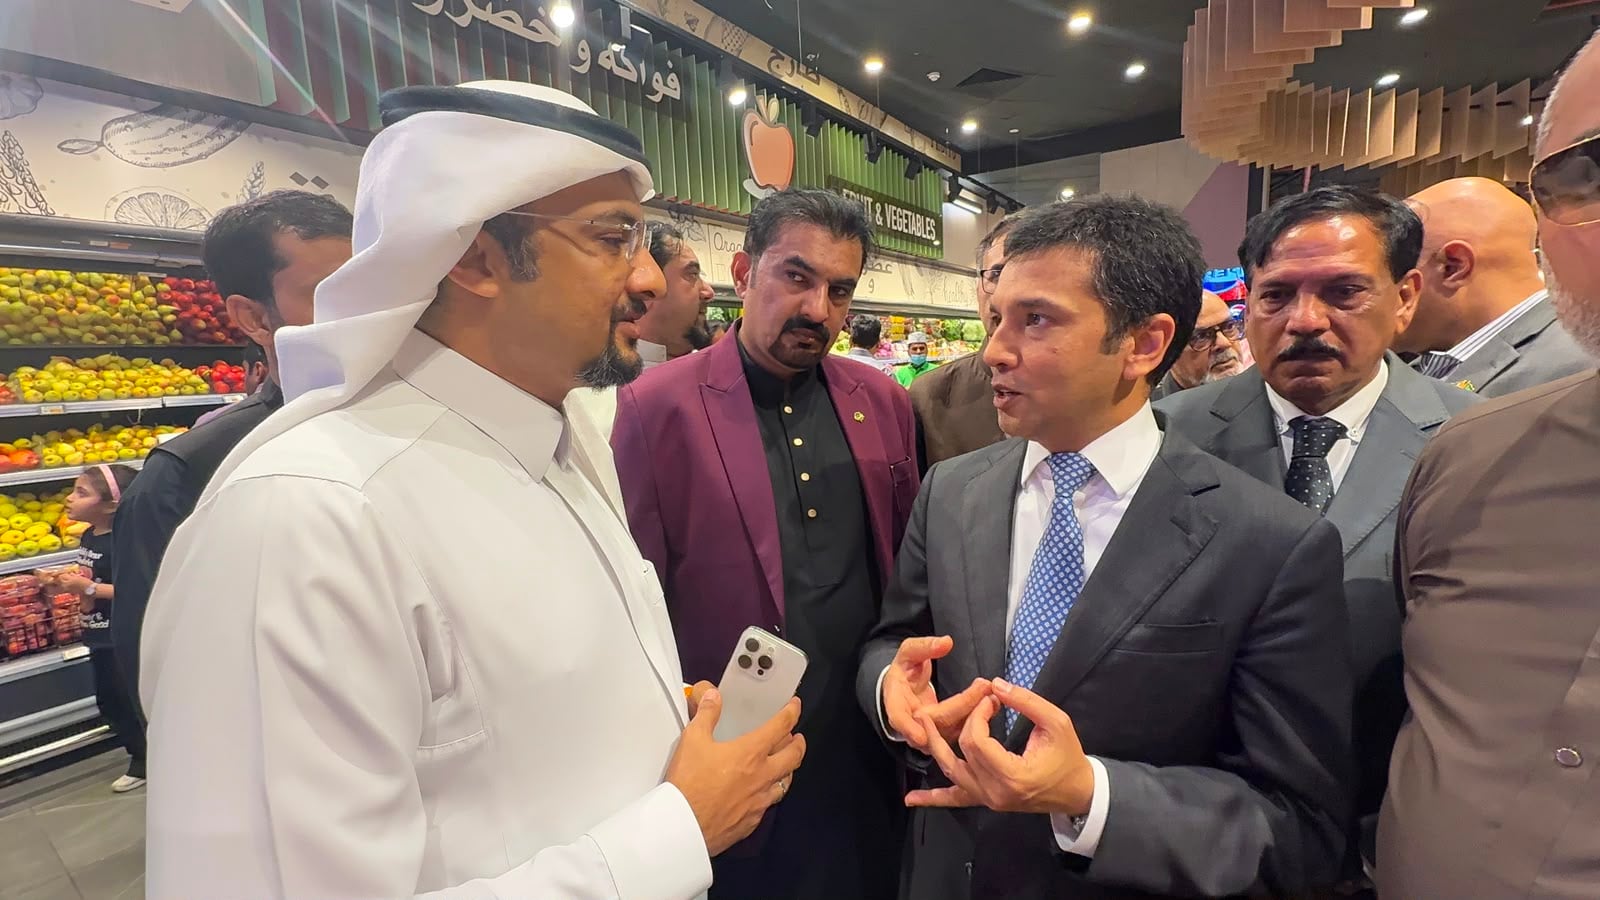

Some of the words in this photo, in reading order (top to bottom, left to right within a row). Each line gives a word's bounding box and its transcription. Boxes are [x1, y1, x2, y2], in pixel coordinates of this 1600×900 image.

[569, 39, 591, 74] و
[875, 202, 884, 226] &
[885, 203, 936, 240] VEGETABLES
